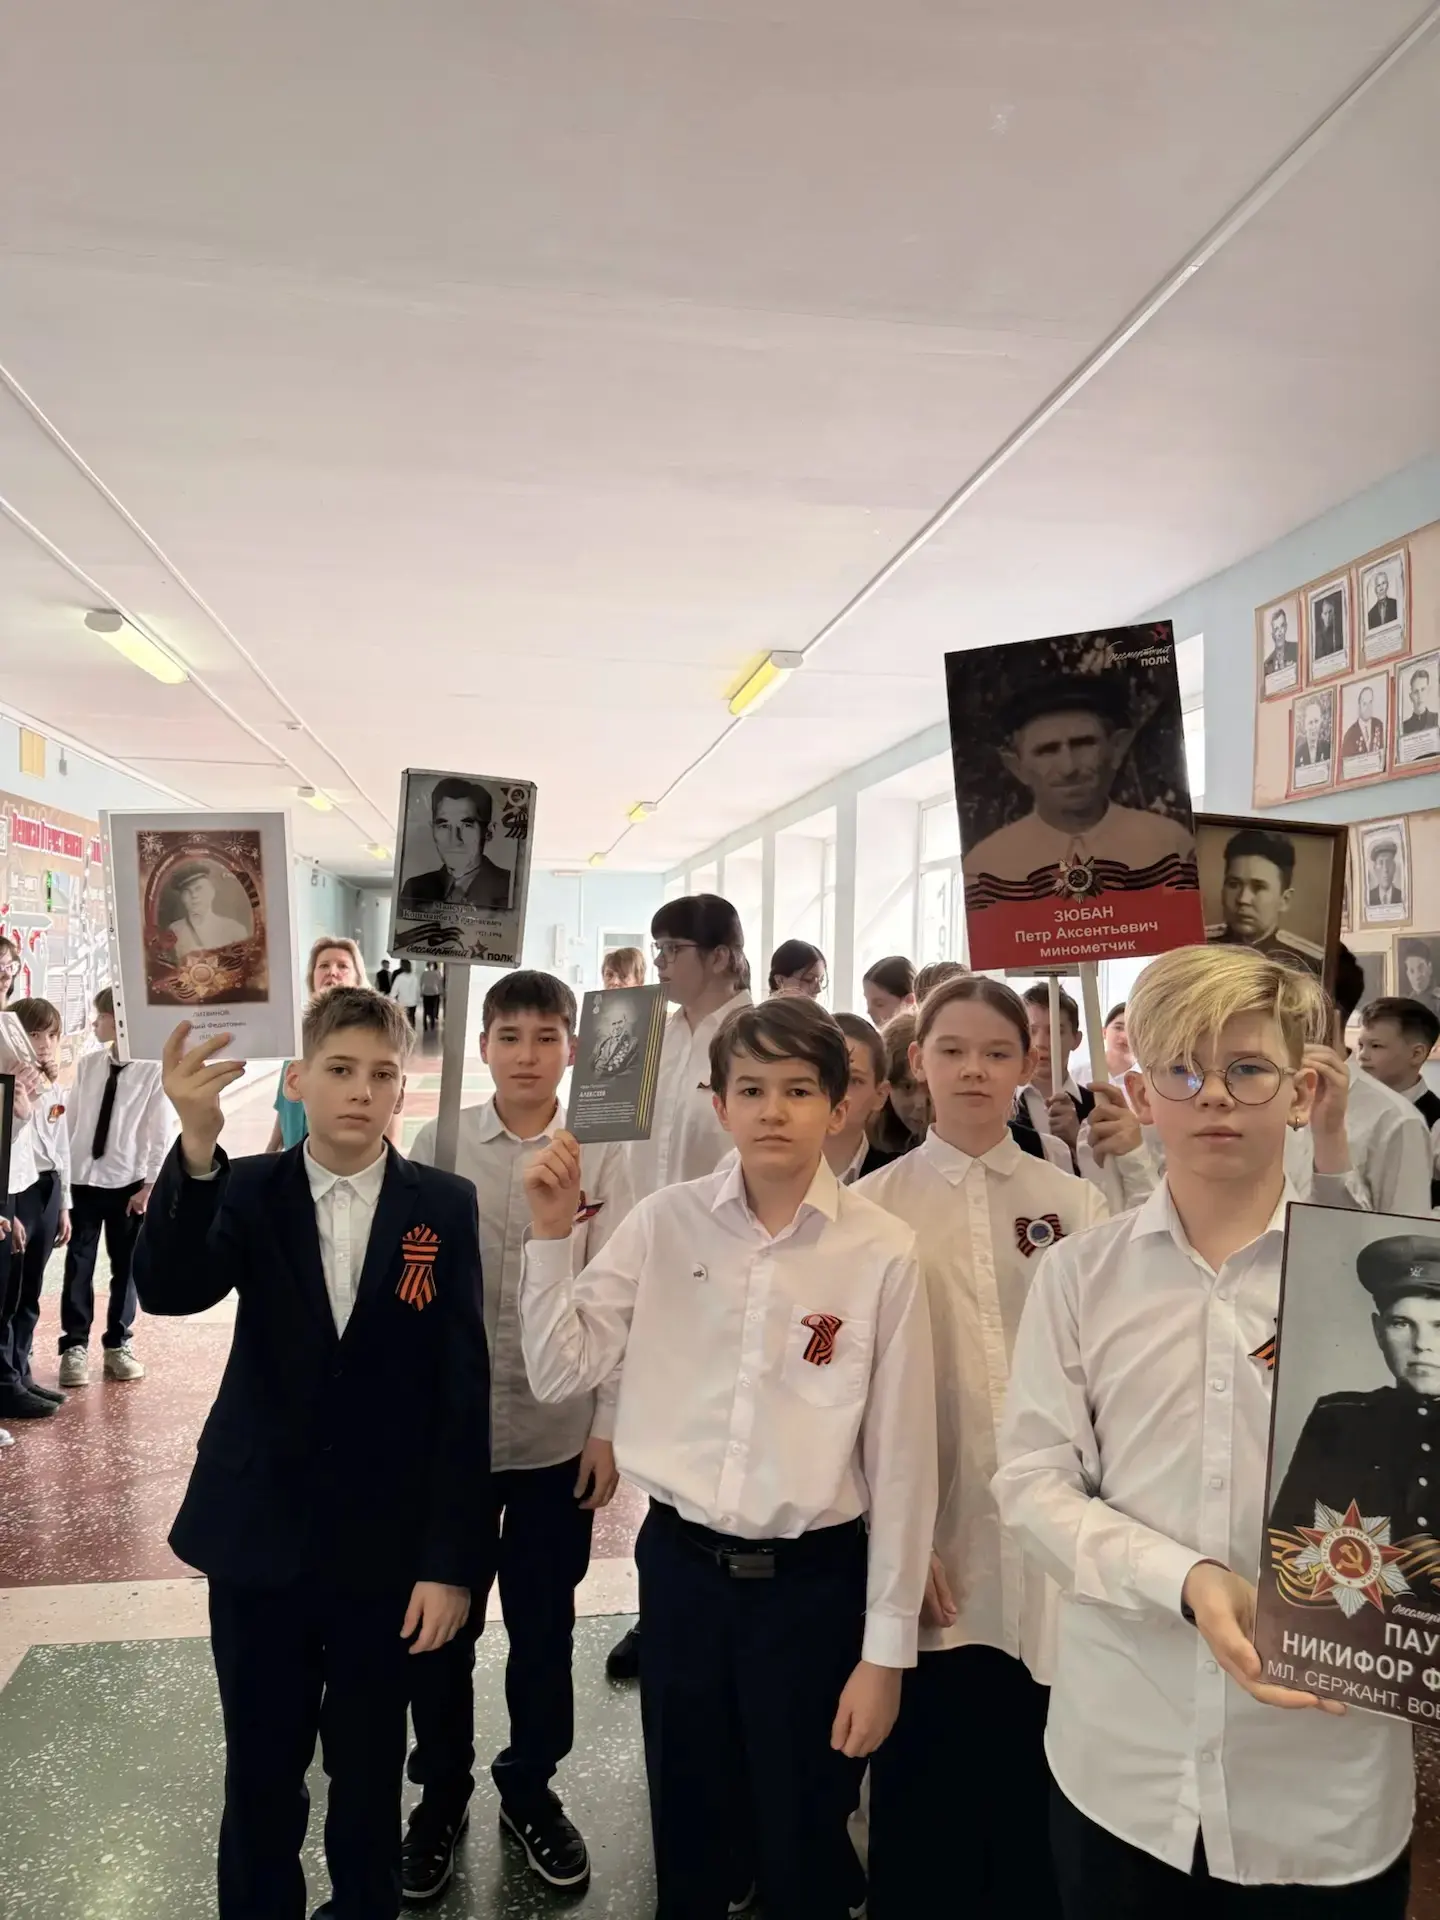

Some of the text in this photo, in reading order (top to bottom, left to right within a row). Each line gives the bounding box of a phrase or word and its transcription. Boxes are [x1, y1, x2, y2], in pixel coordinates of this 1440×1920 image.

[1054, 906, 1113, 922] ЗЮБАН
[1015, 921, 1158, 944] Петр Аксентьевич
[1040, 940, 1136, 957] минометчик
[1385, 1622, 1440, 1656] ПАУ
[1283, 1630, 1413, 1684] НИКИФОР
[1268, 1660, 1299, 1682] МЛ.
[1304, 1671, 1401, 1710] СЕРЖАНТ.
